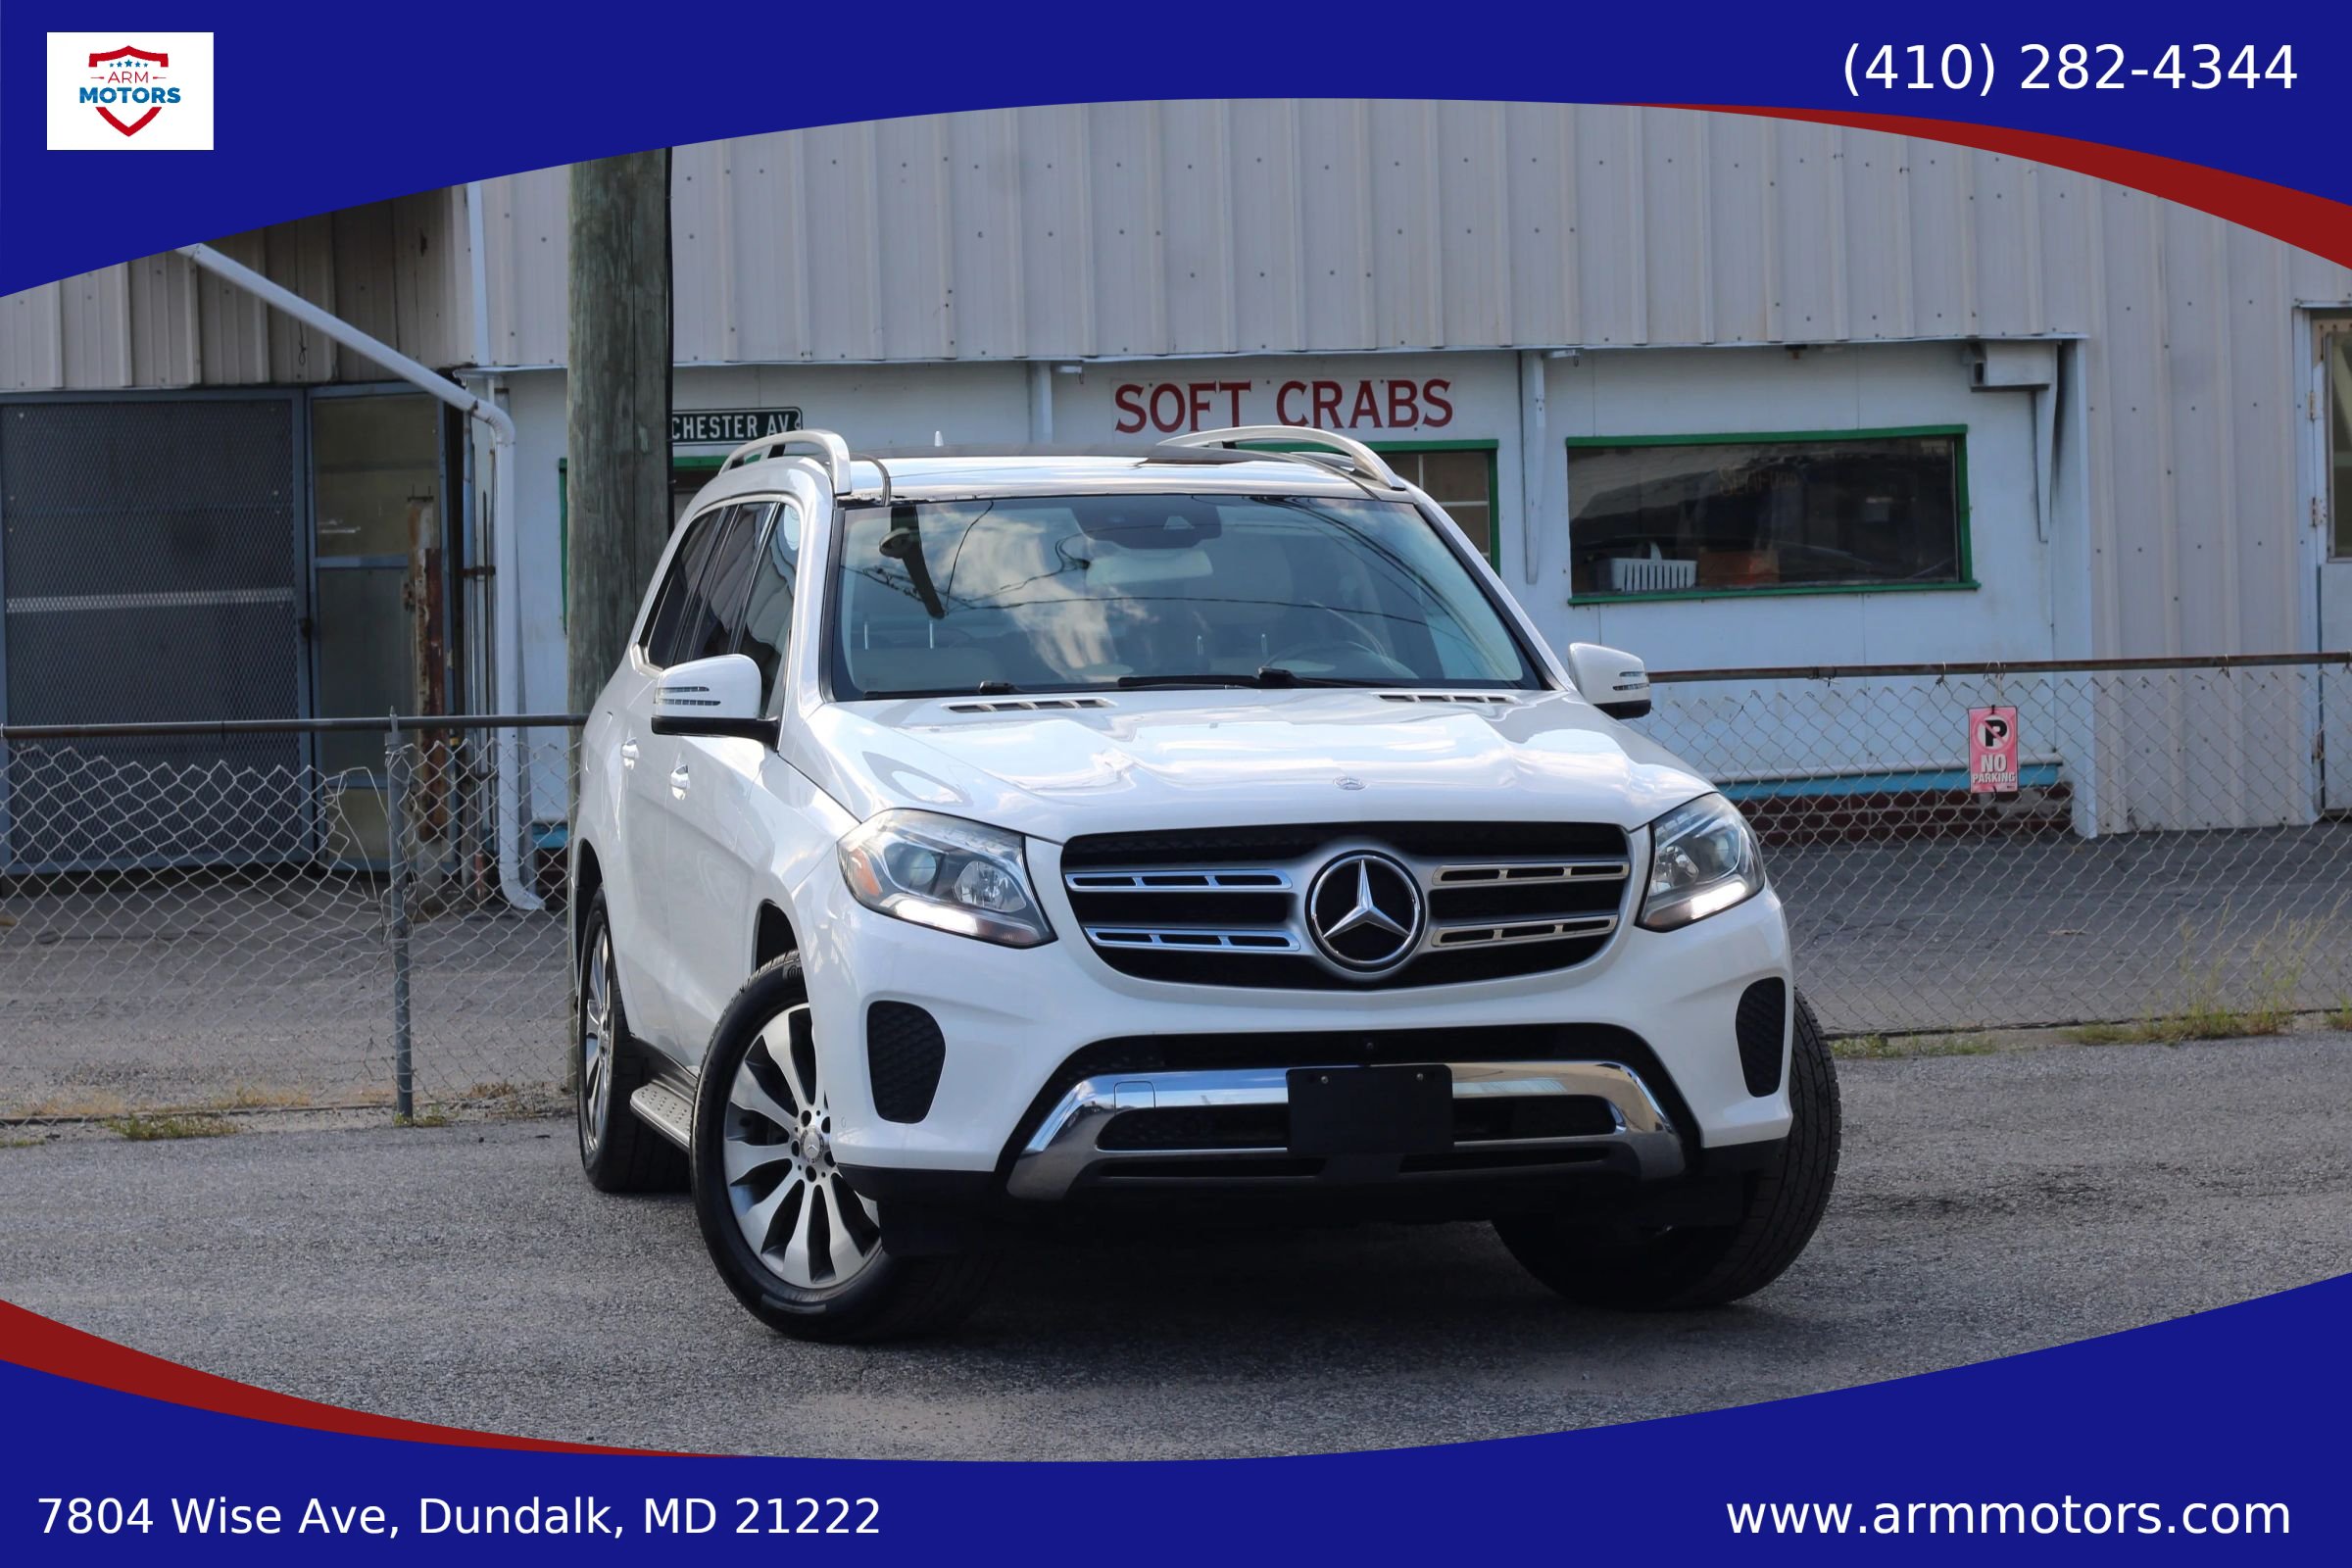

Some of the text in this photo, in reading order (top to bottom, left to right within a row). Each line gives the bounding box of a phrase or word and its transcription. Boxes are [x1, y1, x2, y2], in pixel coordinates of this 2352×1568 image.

[1114, 378, 1453, 433] SOFT CRABS
[1981, 754, 2007, 772] NO
[1972, 772, 2016, 784] PARKING
